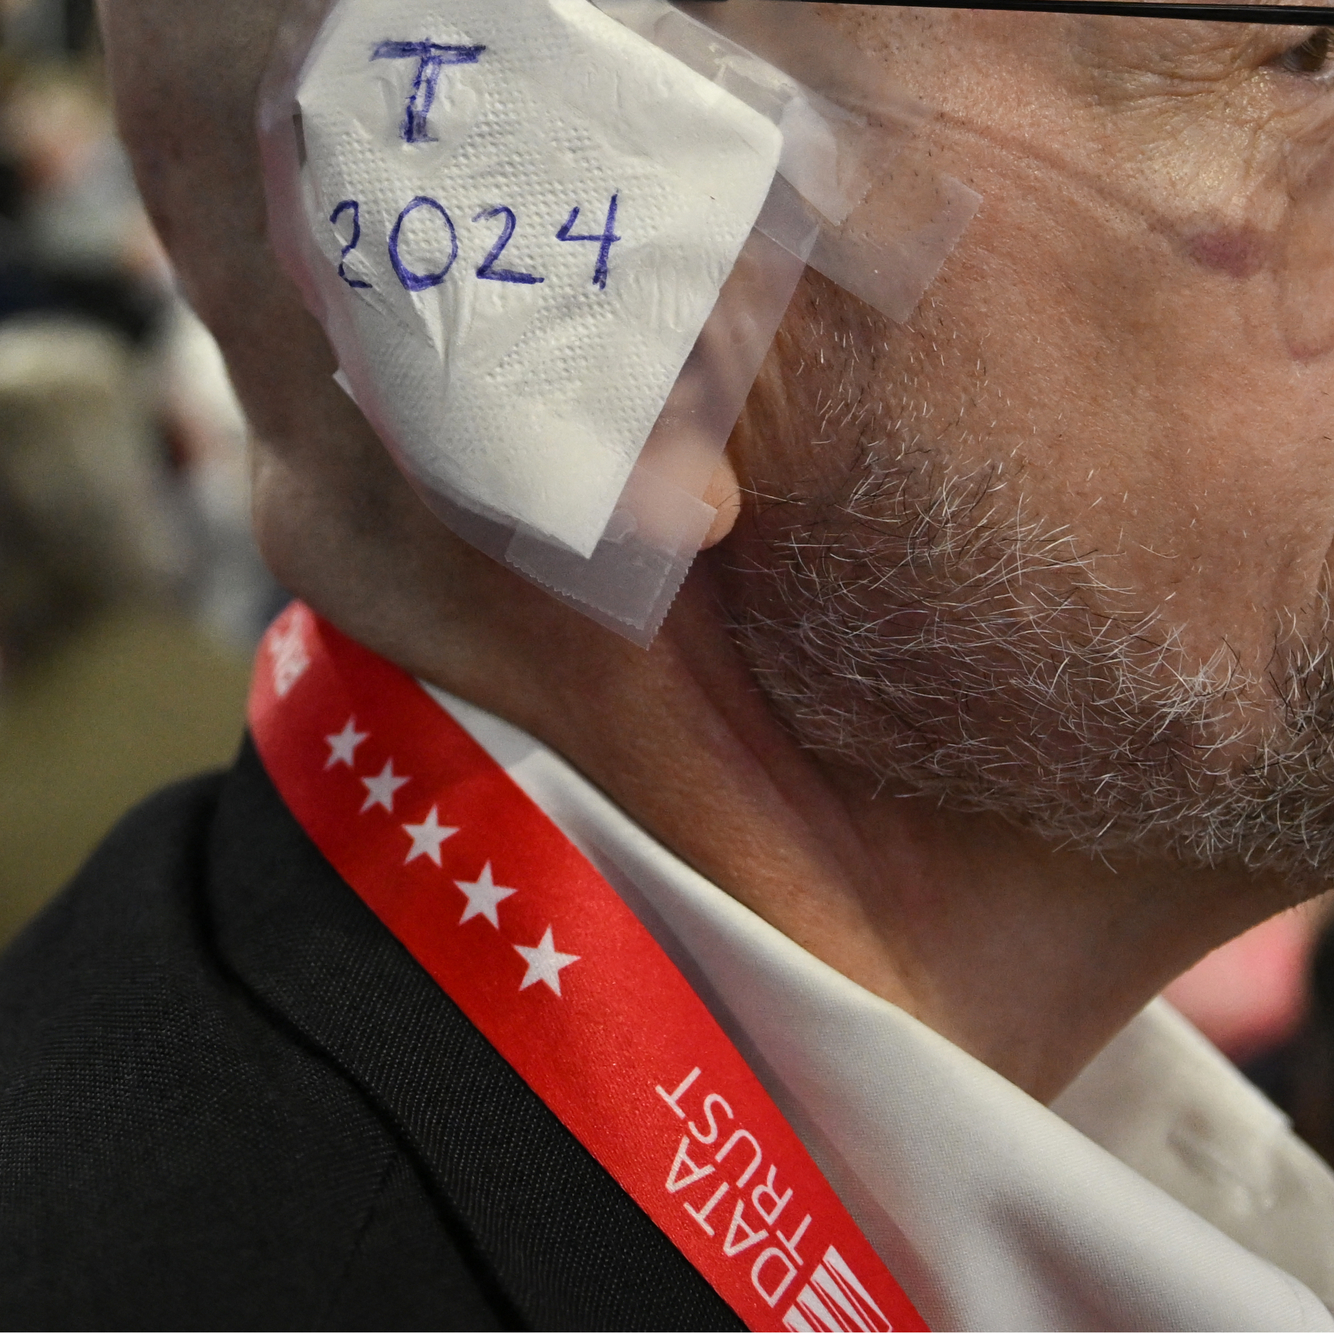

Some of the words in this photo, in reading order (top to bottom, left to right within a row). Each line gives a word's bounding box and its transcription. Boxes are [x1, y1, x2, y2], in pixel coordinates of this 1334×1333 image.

[370, 39, 487, 143] T
[330, 190, 622, 292] 2024
[656, 1067, 812, 1266] TRUST
[665, 1136, 797, 1308] DATA
